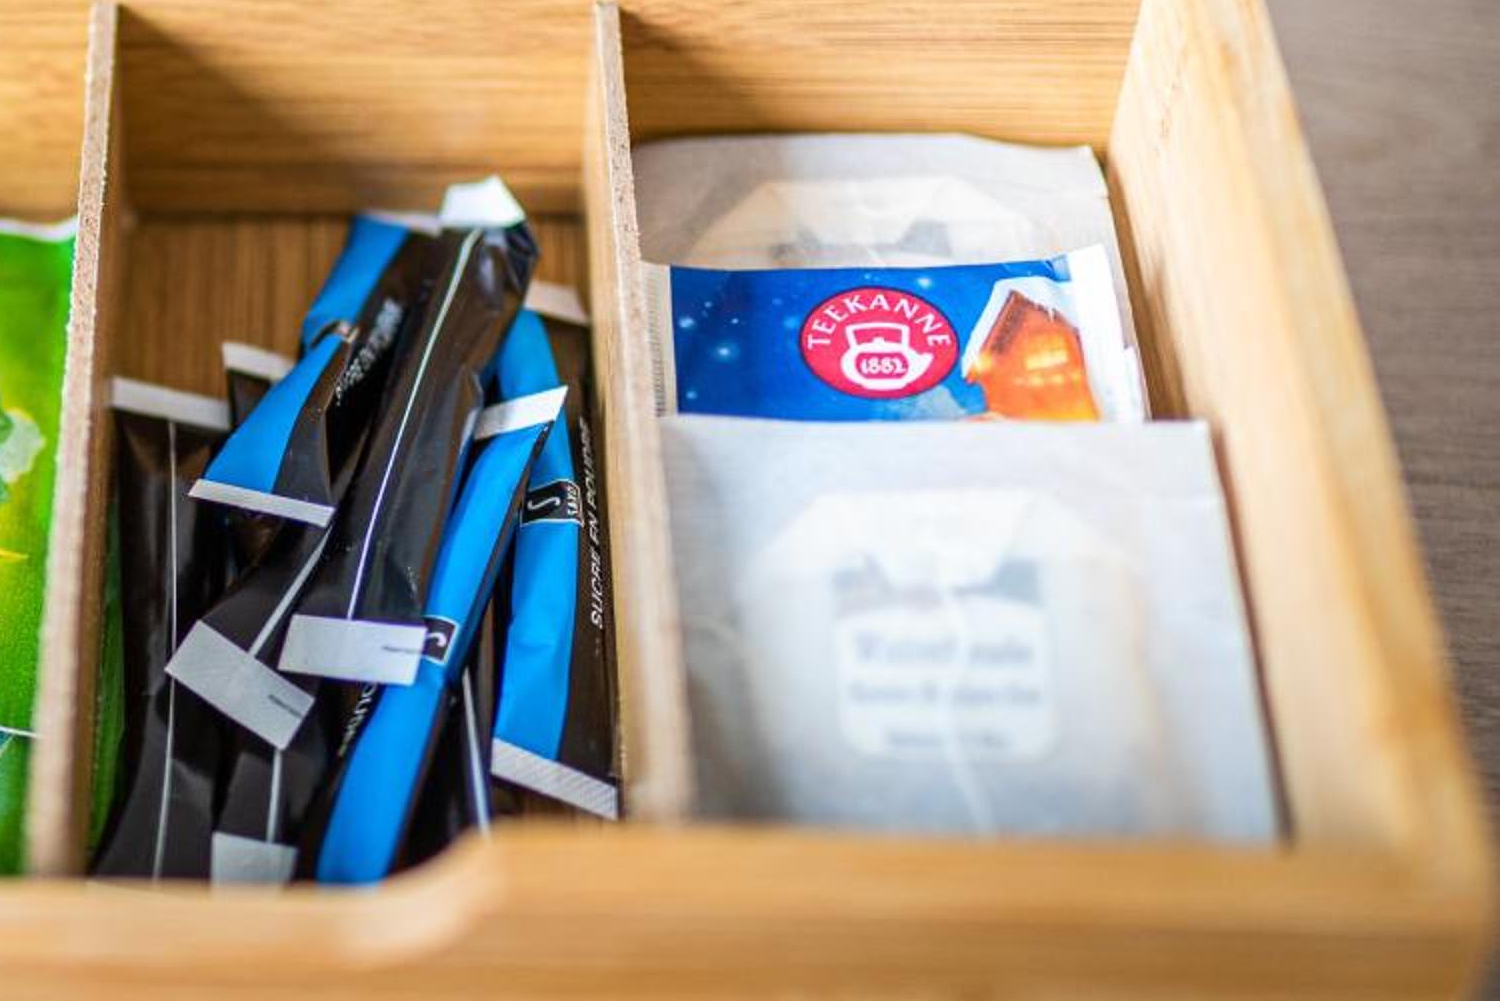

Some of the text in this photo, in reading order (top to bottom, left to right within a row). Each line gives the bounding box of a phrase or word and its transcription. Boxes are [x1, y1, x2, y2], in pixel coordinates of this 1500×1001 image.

[807, 294, 951, 350] TEEKANNE
[860, 357, 907, 375] 1882
[587, 510, 600, 546] EN
[590, 547, 603, 631] SUCRE
